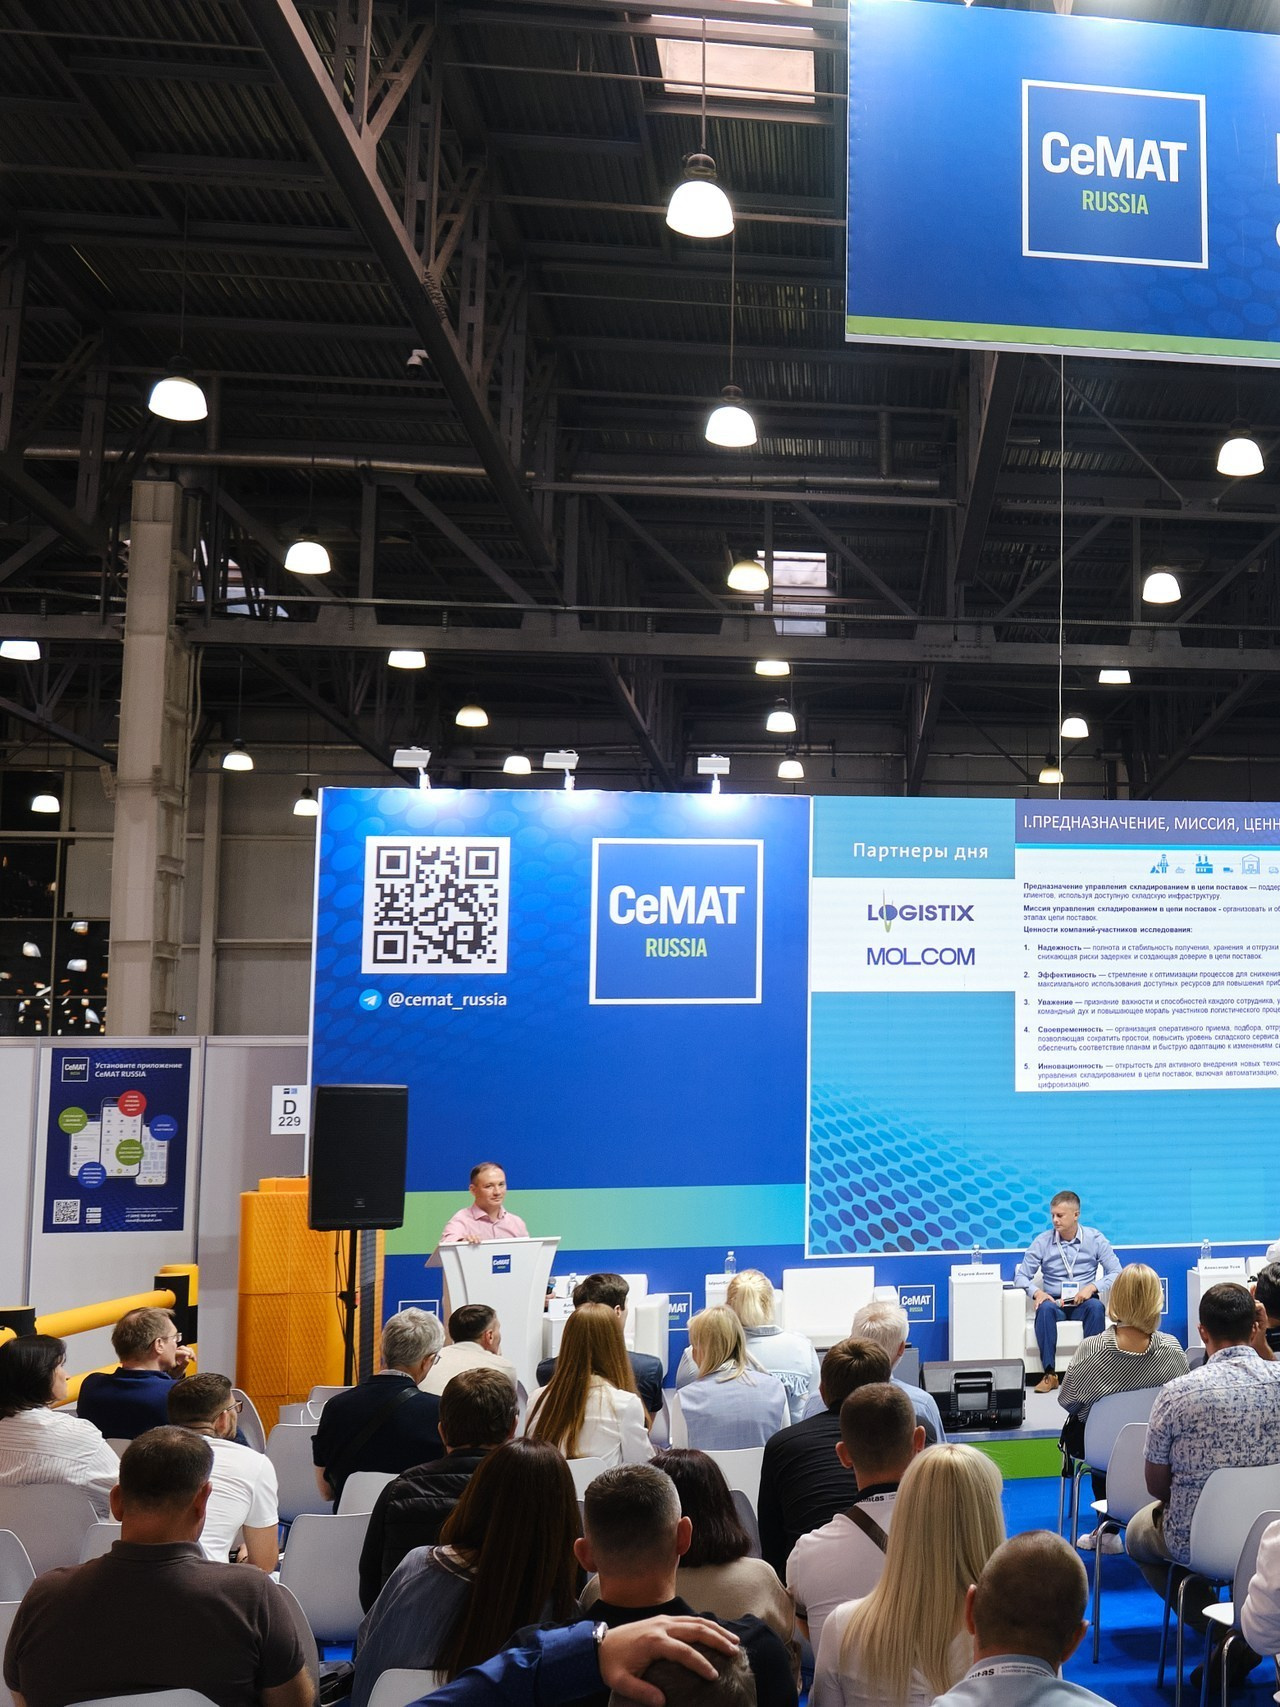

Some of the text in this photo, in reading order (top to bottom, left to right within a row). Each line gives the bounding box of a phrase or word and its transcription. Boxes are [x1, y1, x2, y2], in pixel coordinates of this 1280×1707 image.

[1041, 131, 1188, 183] CeMAT
[1082, 189, 1149, 215] RUSSIA
[1174, 817, 1240, 833] МИССИЯ,
[853, 842, 989, 862] Партнеры дня
[1023, 882, 1083, 892] Предназначение
[1085, 884, 1128, 892] управления
[1129, 884, 1189, 892] складированием
[608, 885, 745, 926] CeMAT
[1023, 904, 1051, 912] Миссия
[1052, 905, 1095, 913] управления
[1097, 905, 1158, 913] складированием
[867, 904, 975, 922] LOGISTIX
[1023, 925, 1192, 934] Ценности компаний-участников исследования:
[645, 937, 708, 958] RUSSIA
[1037, 943, 1082, 952] Надежность
[866, 947, 976, 966] MOLCOM
[1037, 970, 1097, 979] Эффективность
[387, 991, 507, 1011] @cemat_russia
[64, 1063, 87, 1071] CeMAT
[137, 1062, 183, 1070] приложение
[1037, 1061, 1104, 1070] Инновационность
[95, 1070, 147, 1078] CeMAT RUSSIA
[283, 1099, 297, 1115] D
[278, 1116, 301, 1127] 229
[901, 1294, 932, 1306] CeMAT
[669, 1302, 689, 1313] MAT
